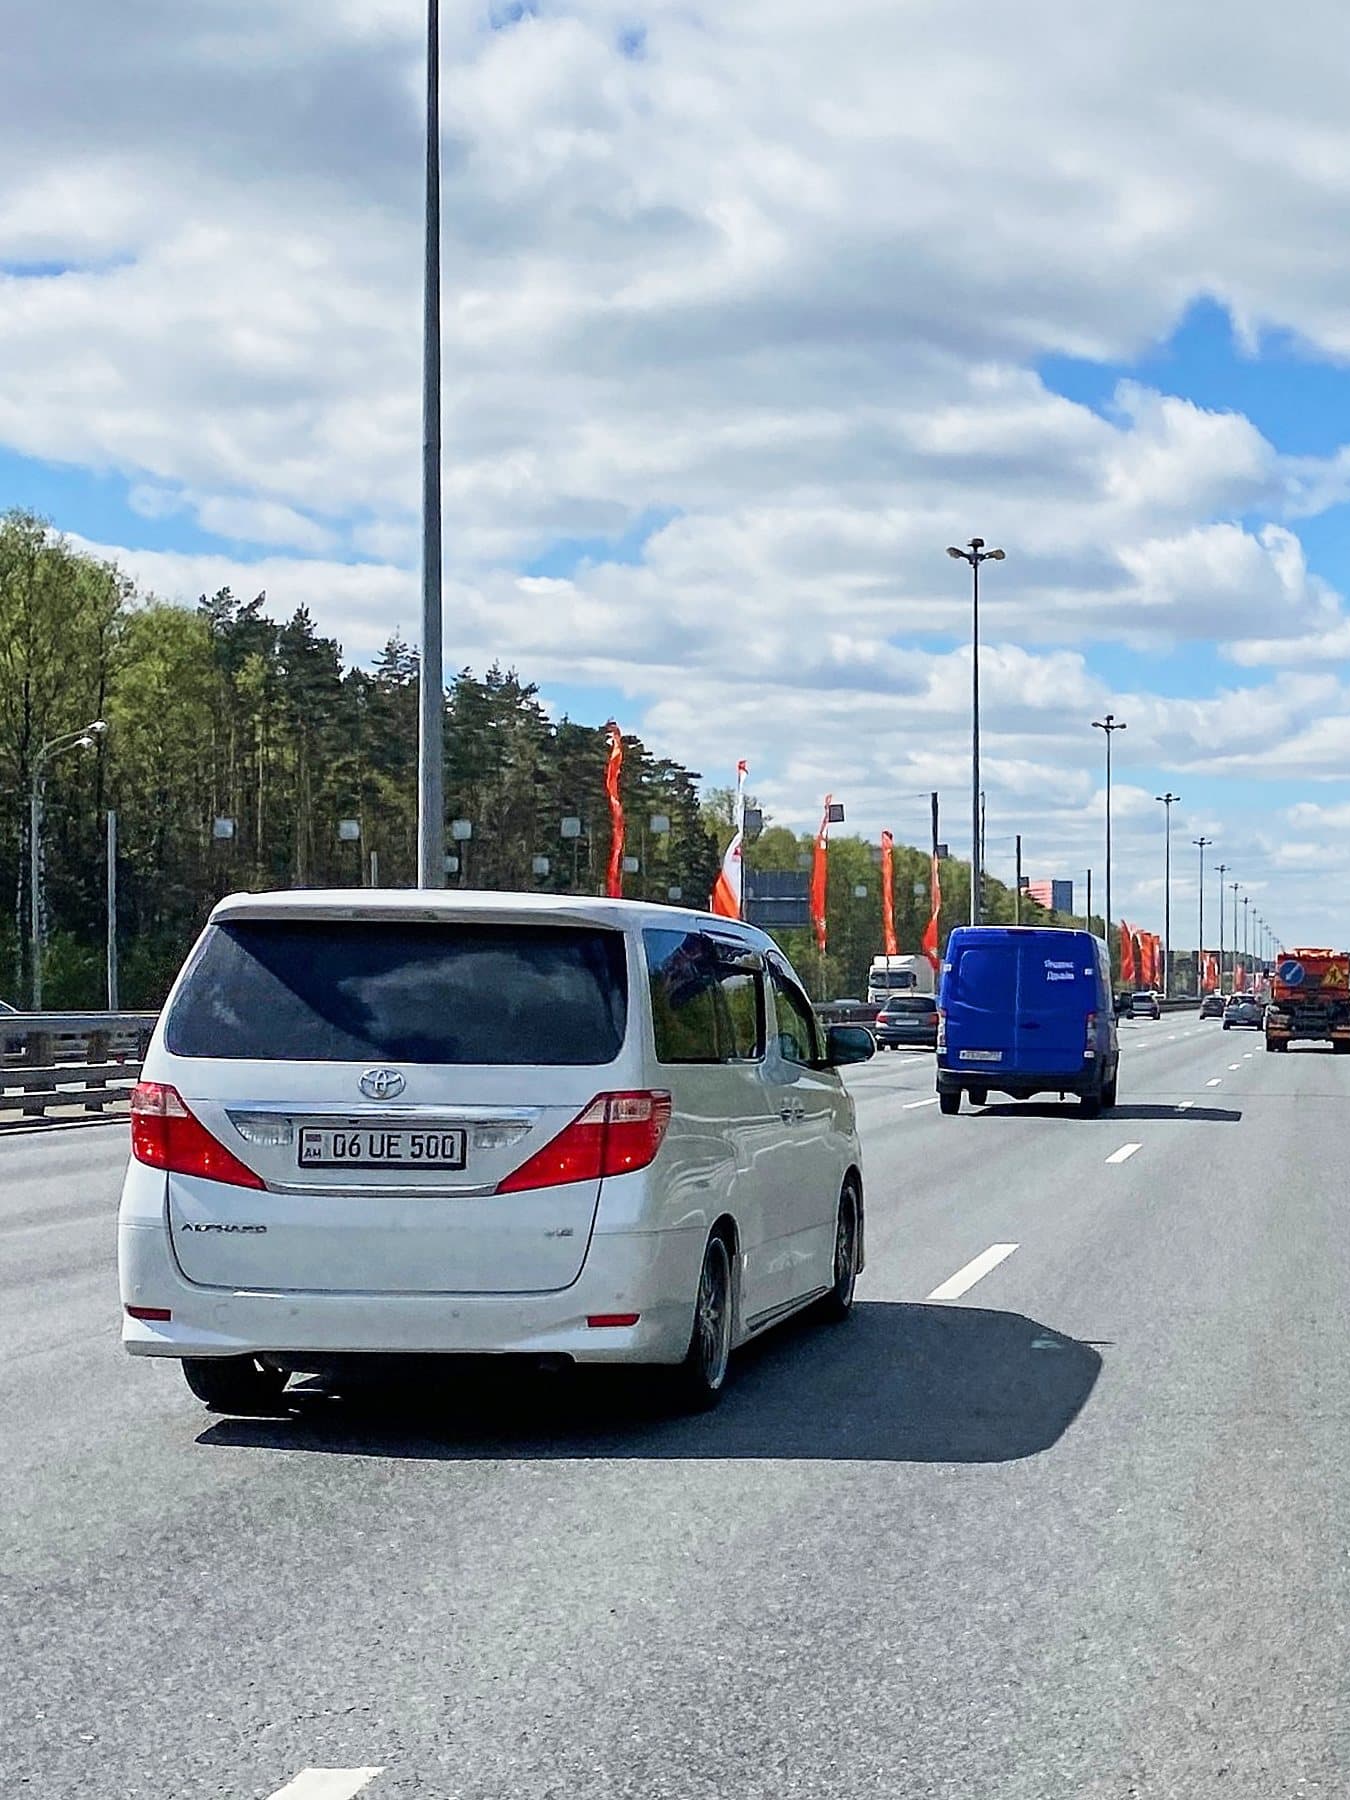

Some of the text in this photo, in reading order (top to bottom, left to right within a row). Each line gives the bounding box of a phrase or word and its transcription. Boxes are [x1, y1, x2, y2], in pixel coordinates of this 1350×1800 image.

[304, 1147, 322, 1158] AM
[333, 1133, 455, 1159] 06 UE 500
